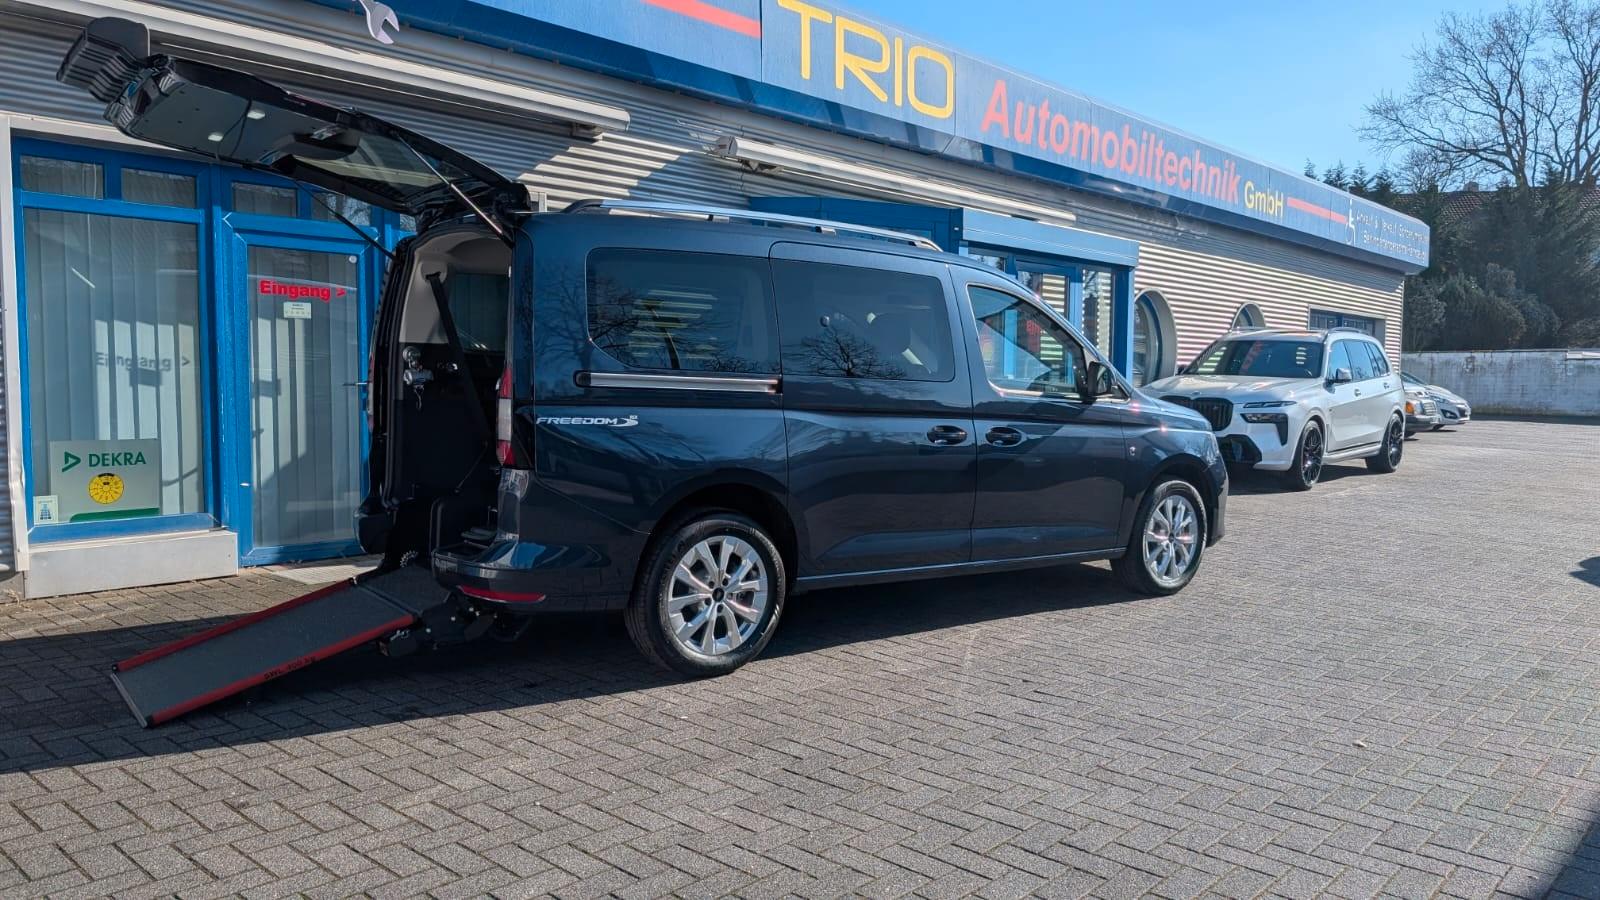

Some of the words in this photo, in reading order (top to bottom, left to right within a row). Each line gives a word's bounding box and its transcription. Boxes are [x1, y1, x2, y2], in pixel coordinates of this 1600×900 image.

[778, 0, 954, 119] TRIO
[980, 79, 1241, 206] Automobiltechnik
[1244, 180, 1284, 217] GmbH
[259, 279, 331, 303] Eingang
[535, 417, 618, 425] FREEDOM
[88, 451, 147, 468] DEKRA
